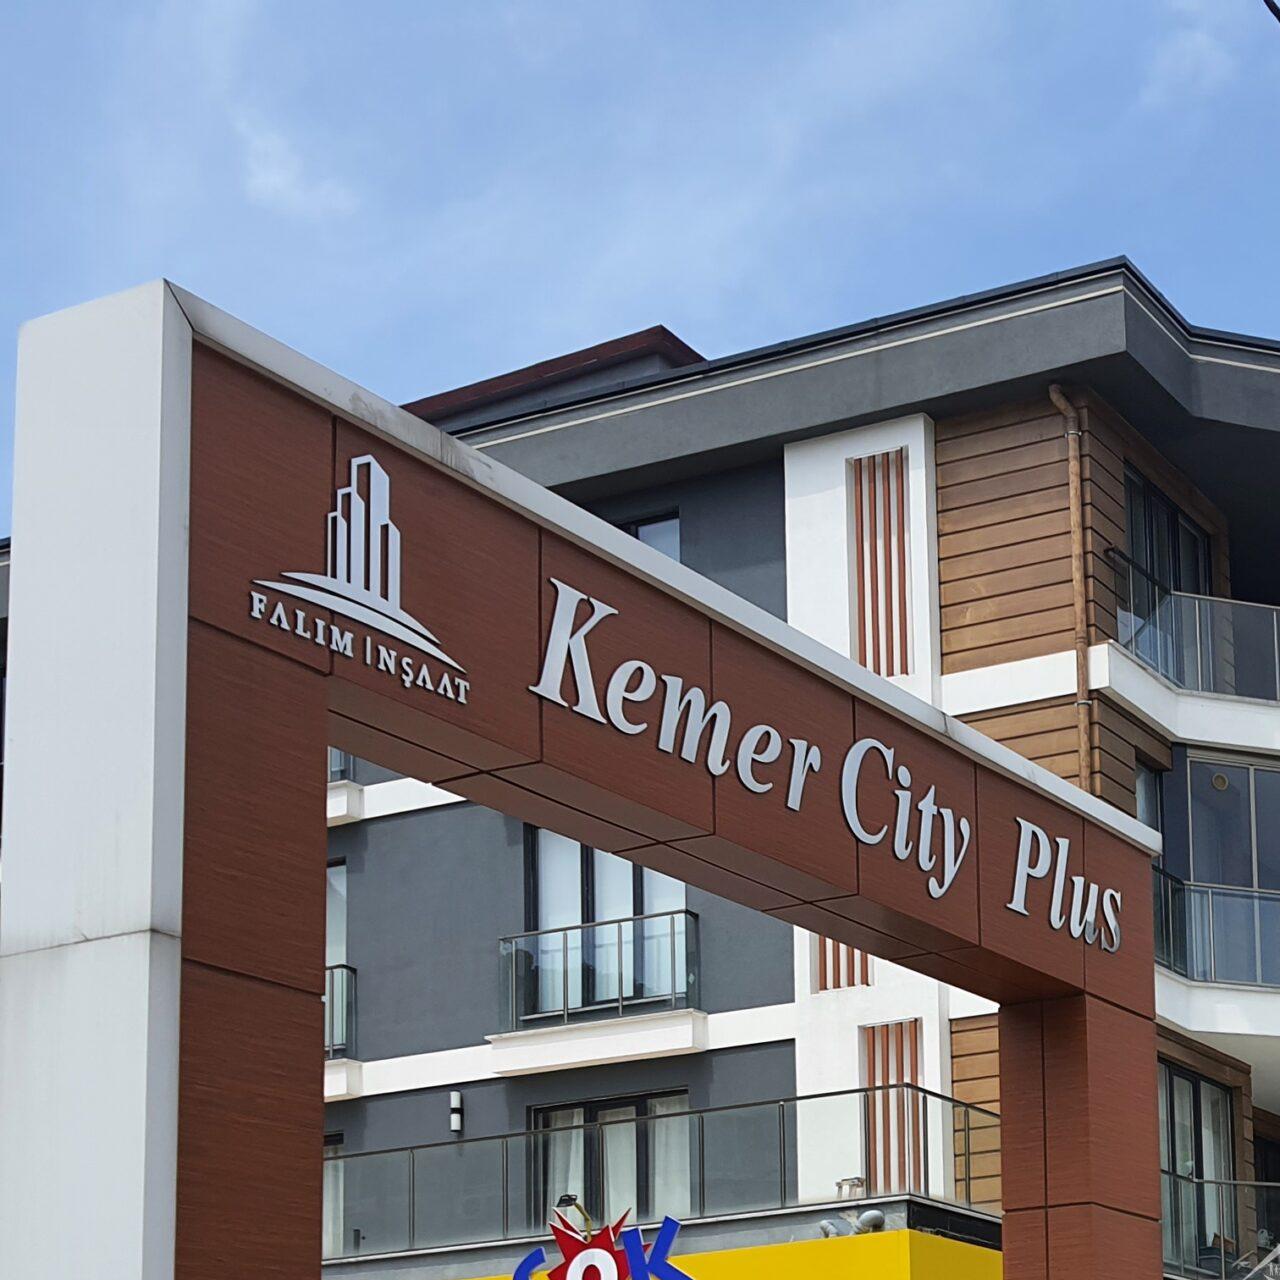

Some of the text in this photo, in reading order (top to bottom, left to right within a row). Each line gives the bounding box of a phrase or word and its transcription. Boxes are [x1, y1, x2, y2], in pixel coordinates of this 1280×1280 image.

[250, 591, 354, 658] FALIM
[528, 577, 1123, 954] Kemer City Plus
